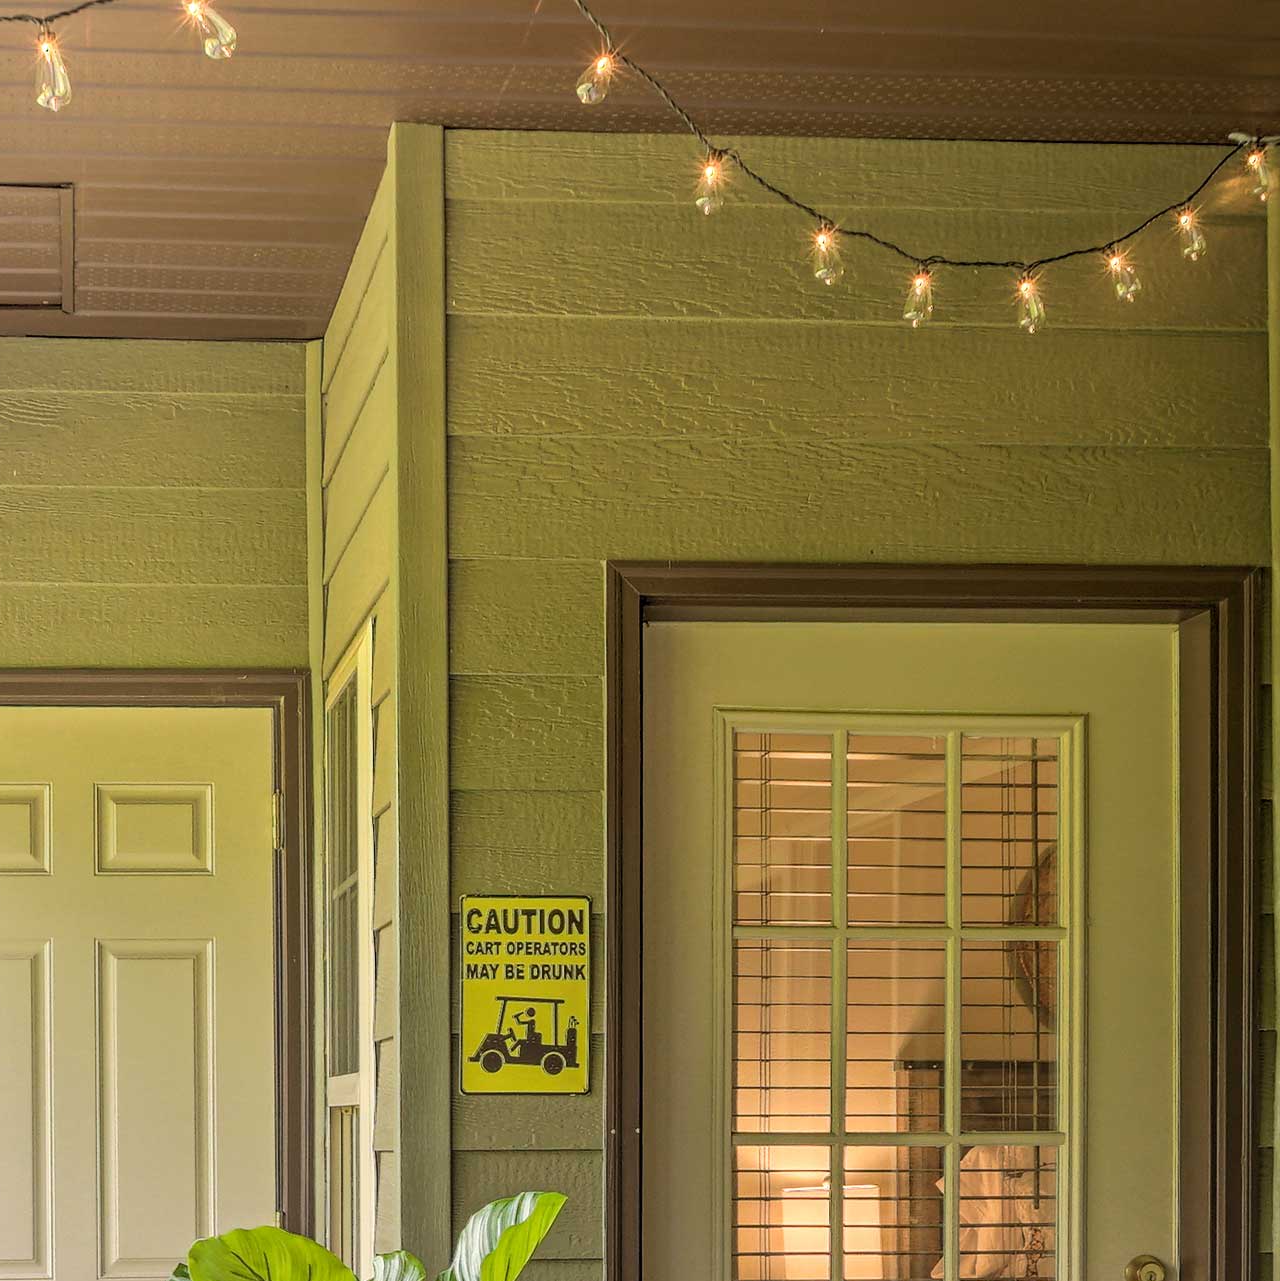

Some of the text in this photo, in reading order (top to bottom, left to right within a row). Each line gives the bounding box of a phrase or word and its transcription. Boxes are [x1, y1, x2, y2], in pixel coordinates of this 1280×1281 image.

[467, 909, 584, 935] CAUTION
[466, 942, 586, 956] CART OPERATORS
[466, 965, 586, 981] MAY BE DRUNK
